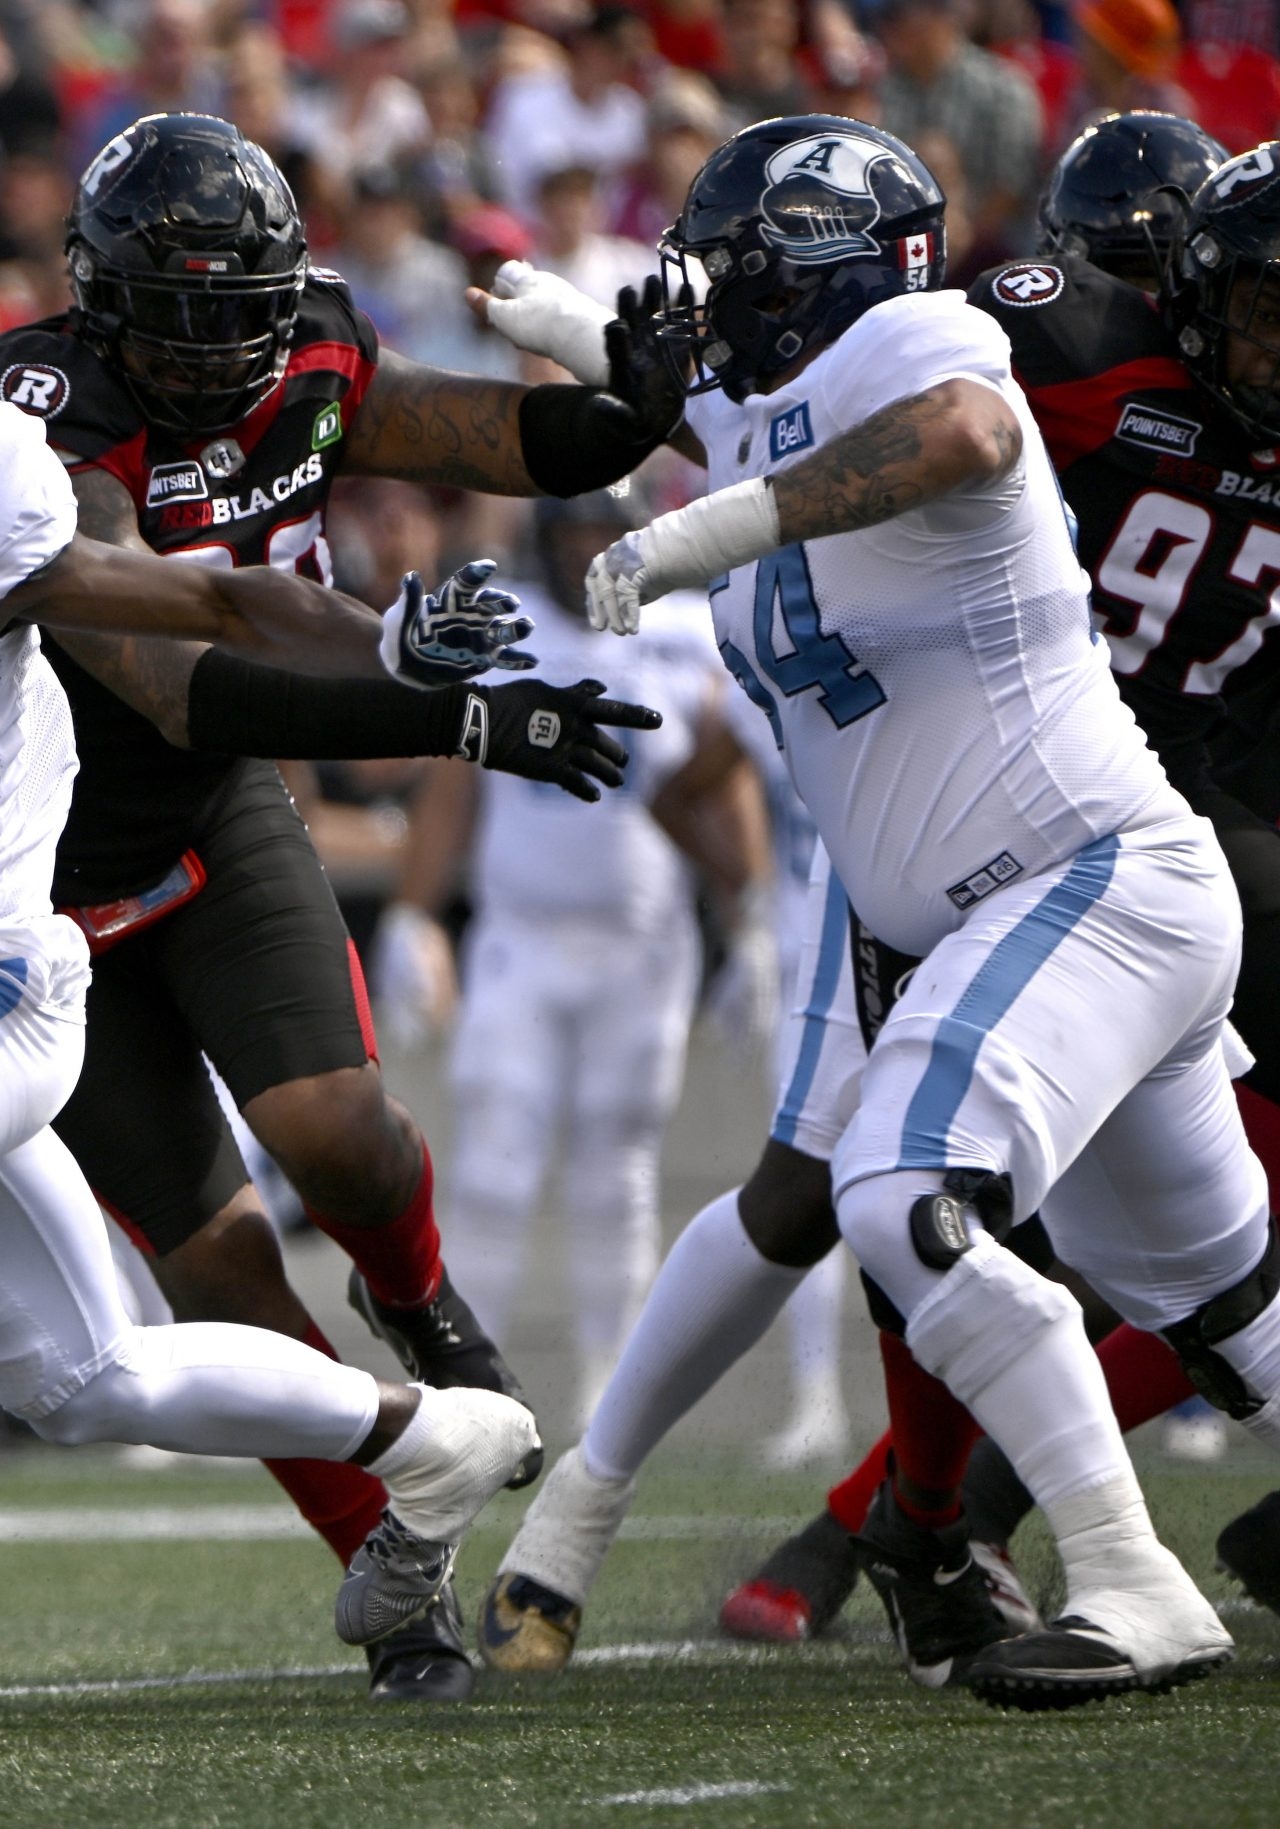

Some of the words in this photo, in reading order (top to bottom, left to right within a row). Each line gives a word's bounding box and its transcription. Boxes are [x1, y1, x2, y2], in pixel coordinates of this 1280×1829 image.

[793, 141, 842, 173] A
[906, 269, 928, 291] 54
[1002, 269, 1055, 299] R
[10, 369, 58, 409] R
[776, 409, 808, 451] Bell
[1122, 414, 1193, 444] POINTSBET
[1092, 491, 1280, 694] 97
[535, 715, 553, 741] CFL
[996, 860, 1014, 877] 46
